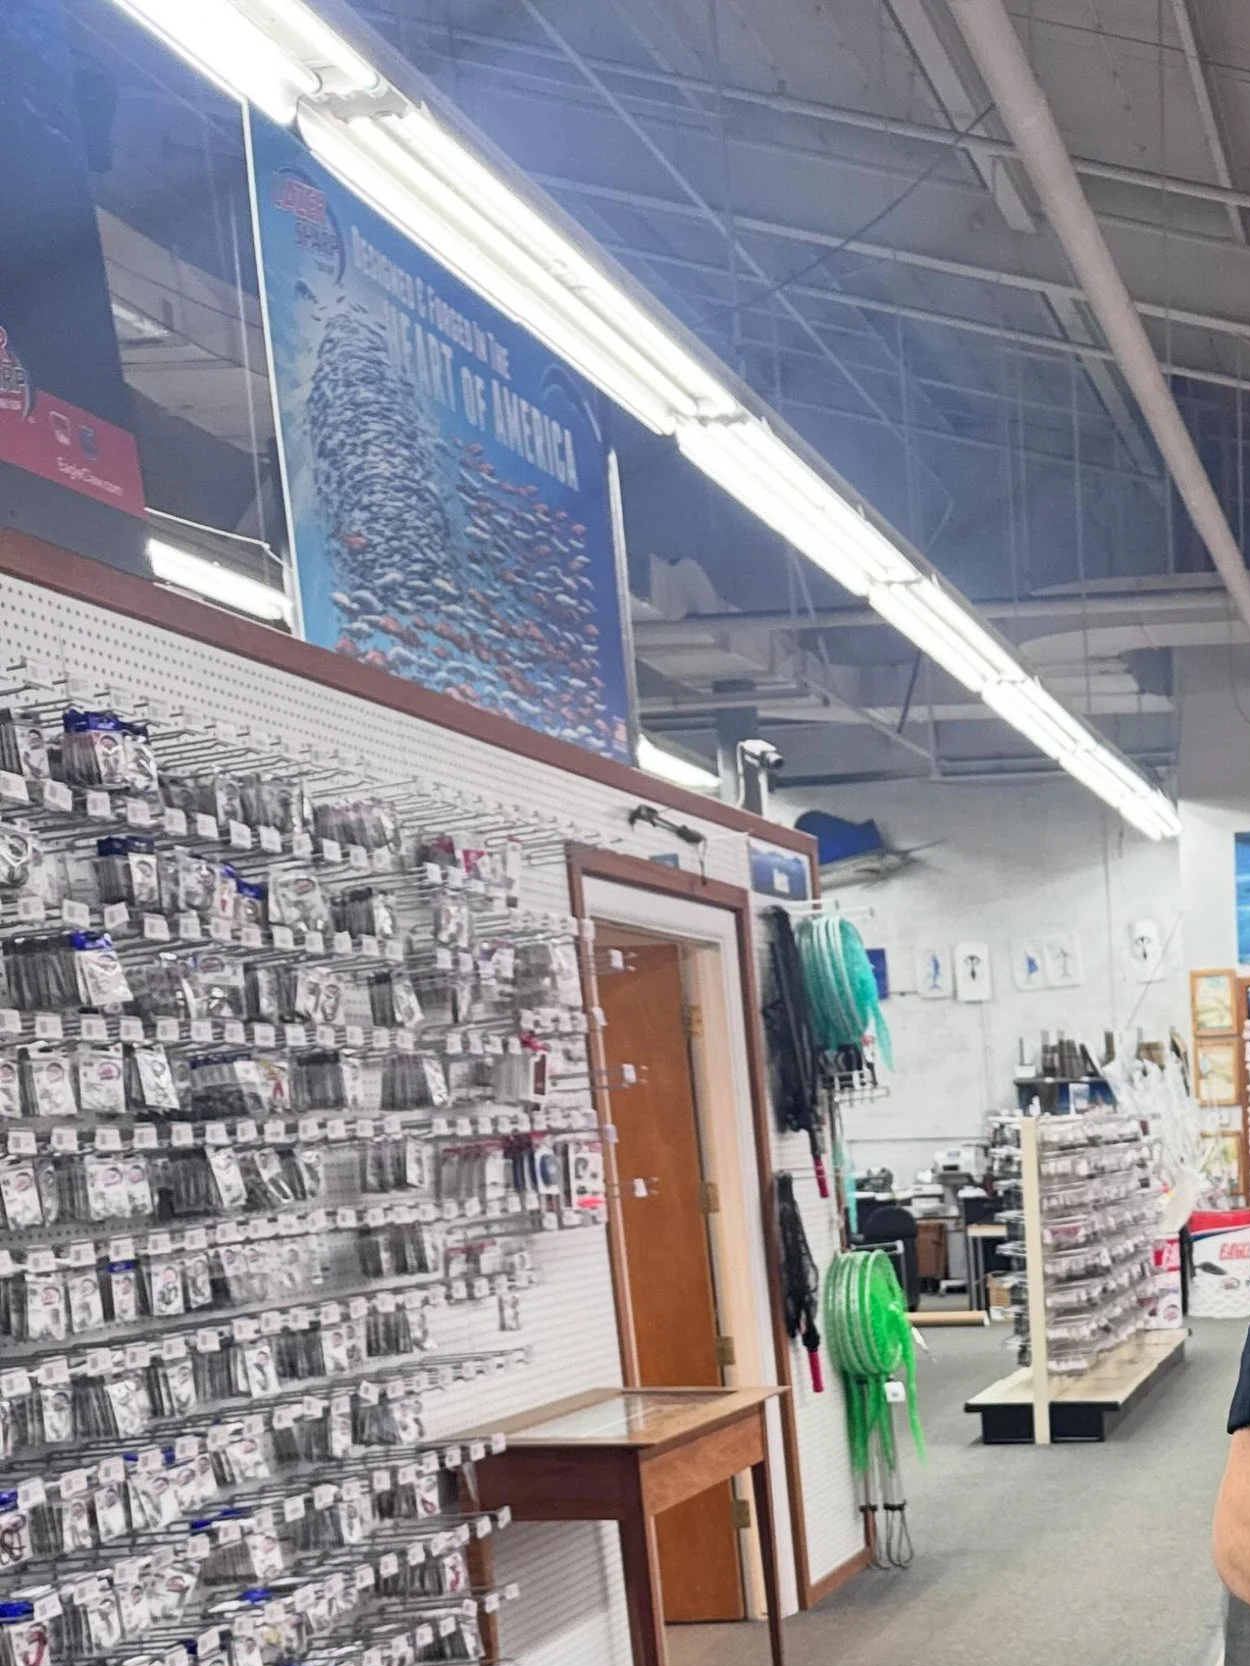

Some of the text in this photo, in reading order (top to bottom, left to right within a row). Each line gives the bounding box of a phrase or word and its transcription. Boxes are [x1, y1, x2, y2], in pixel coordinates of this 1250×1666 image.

[382, 298, 580, 492] HEART OF AMERICA
